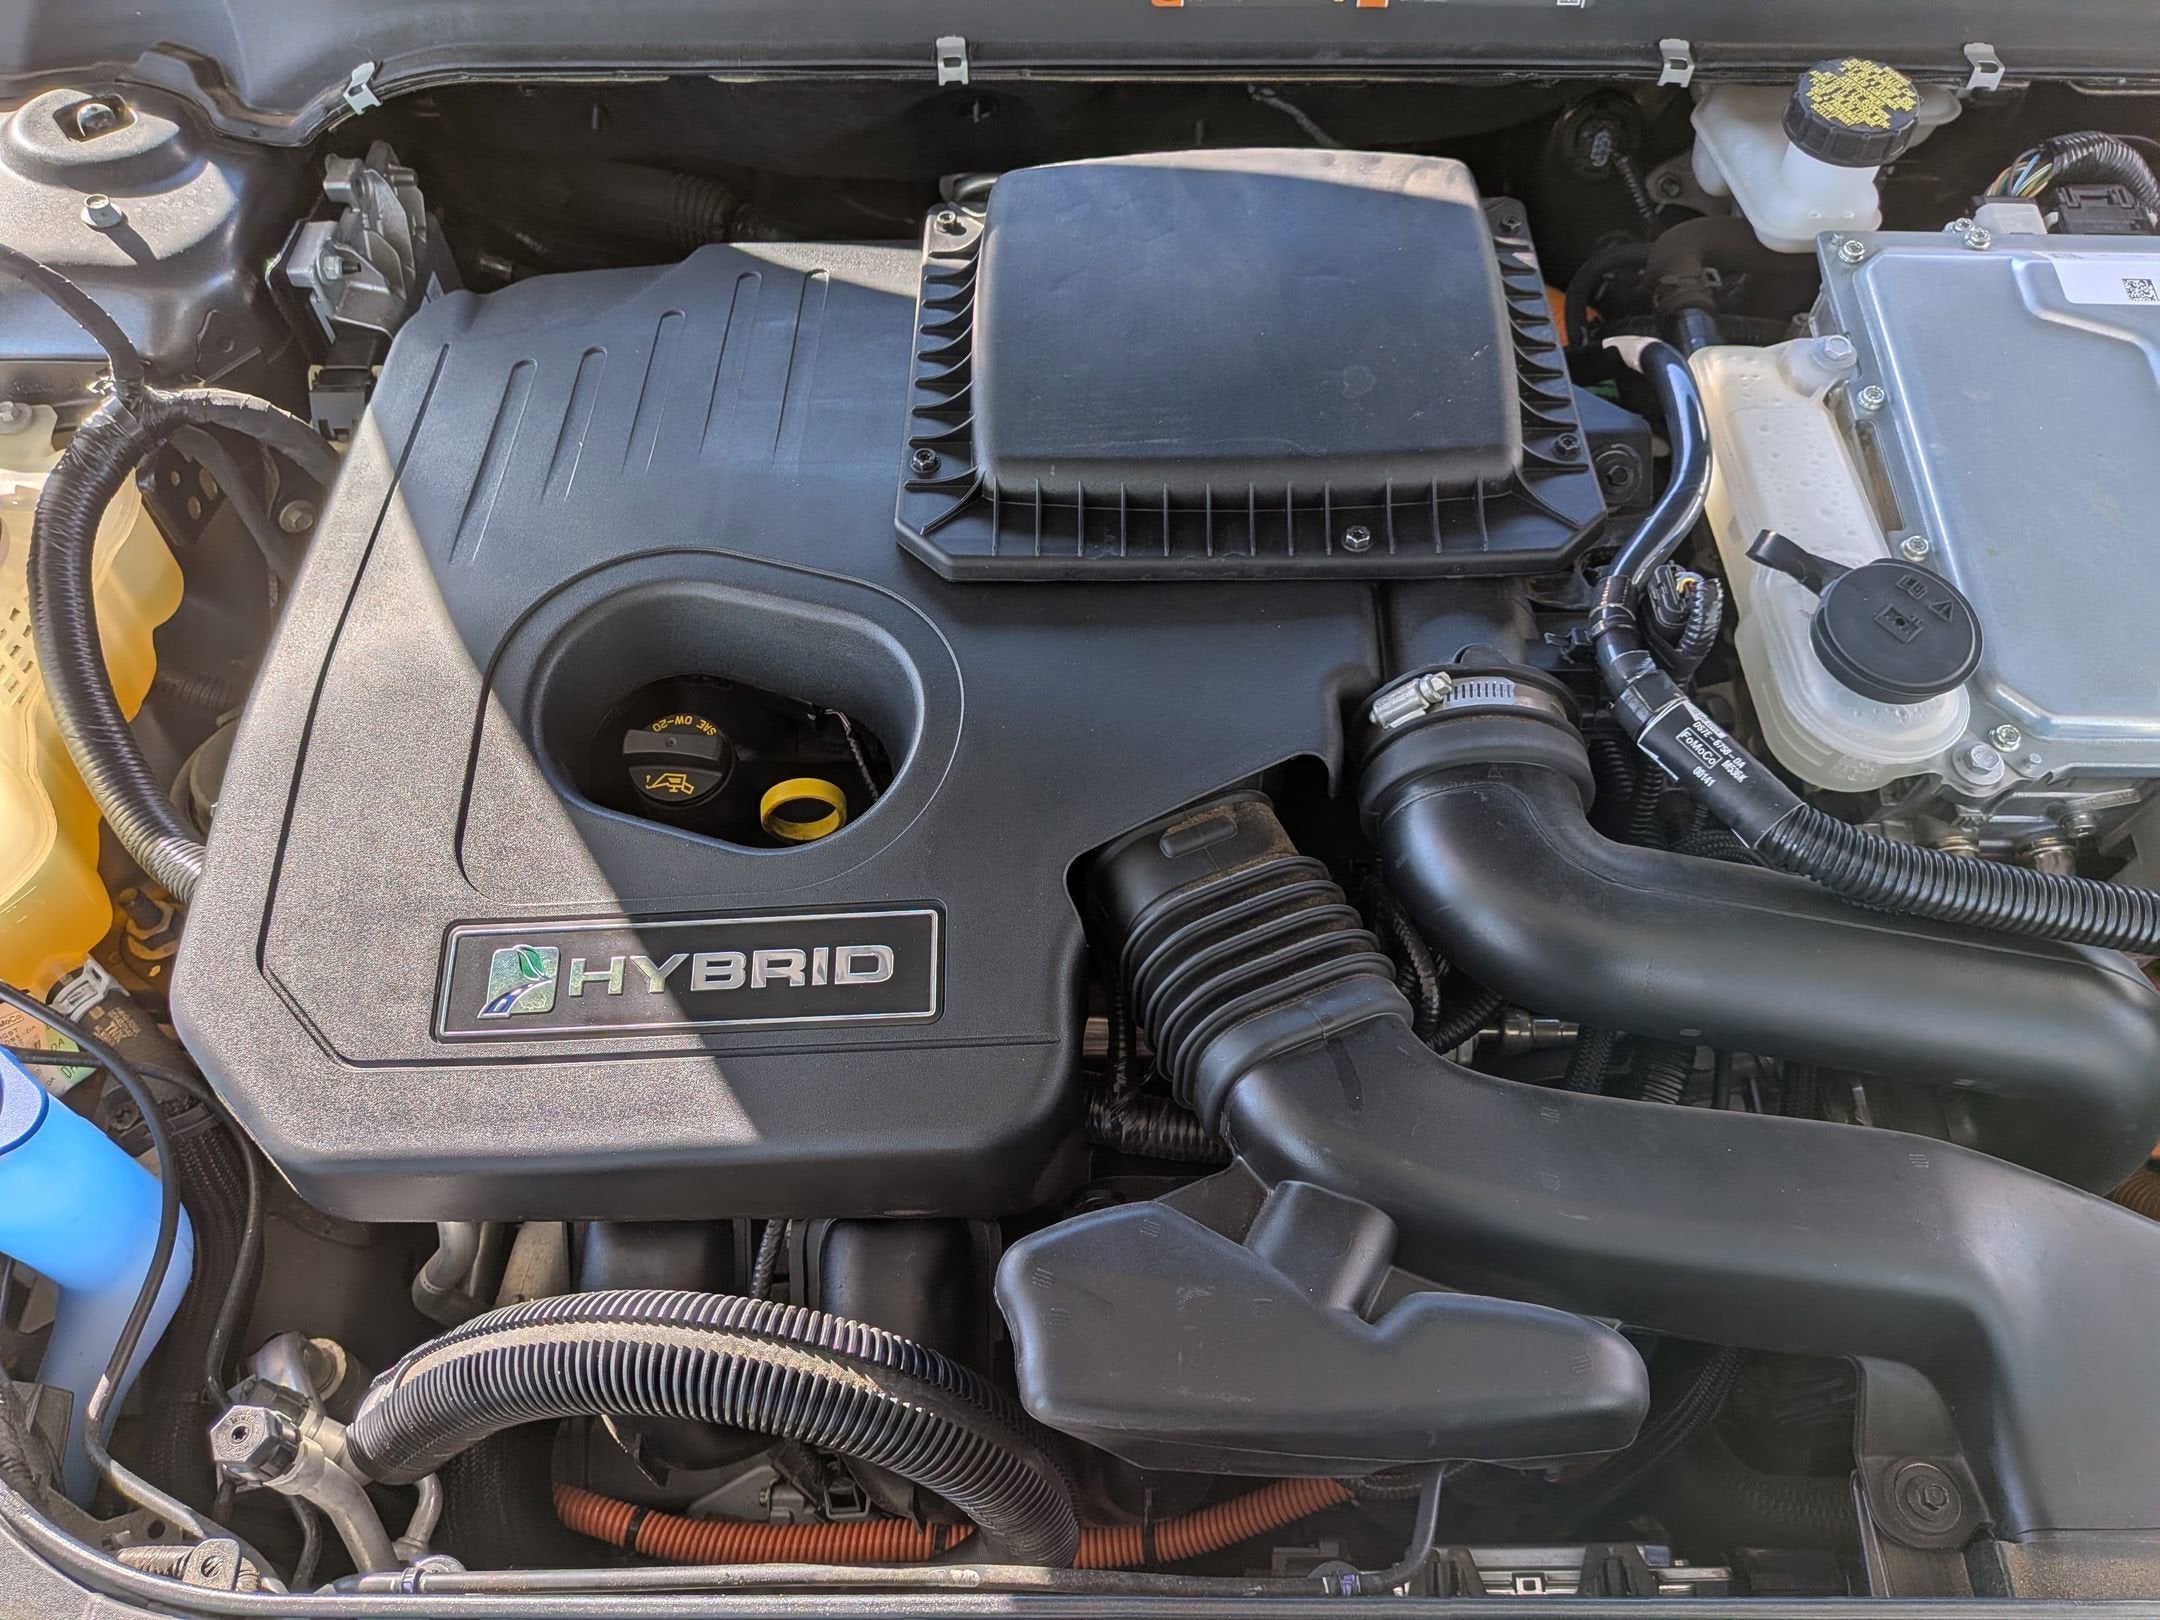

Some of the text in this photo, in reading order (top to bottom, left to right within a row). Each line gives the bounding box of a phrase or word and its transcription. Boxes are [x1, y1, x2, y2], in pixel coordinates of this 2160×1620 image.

[696, 719, 717, 736] SAE
[1680, 730, 1716, 765] FoMoCo
[568, 944, 895, 997] HYBRID
